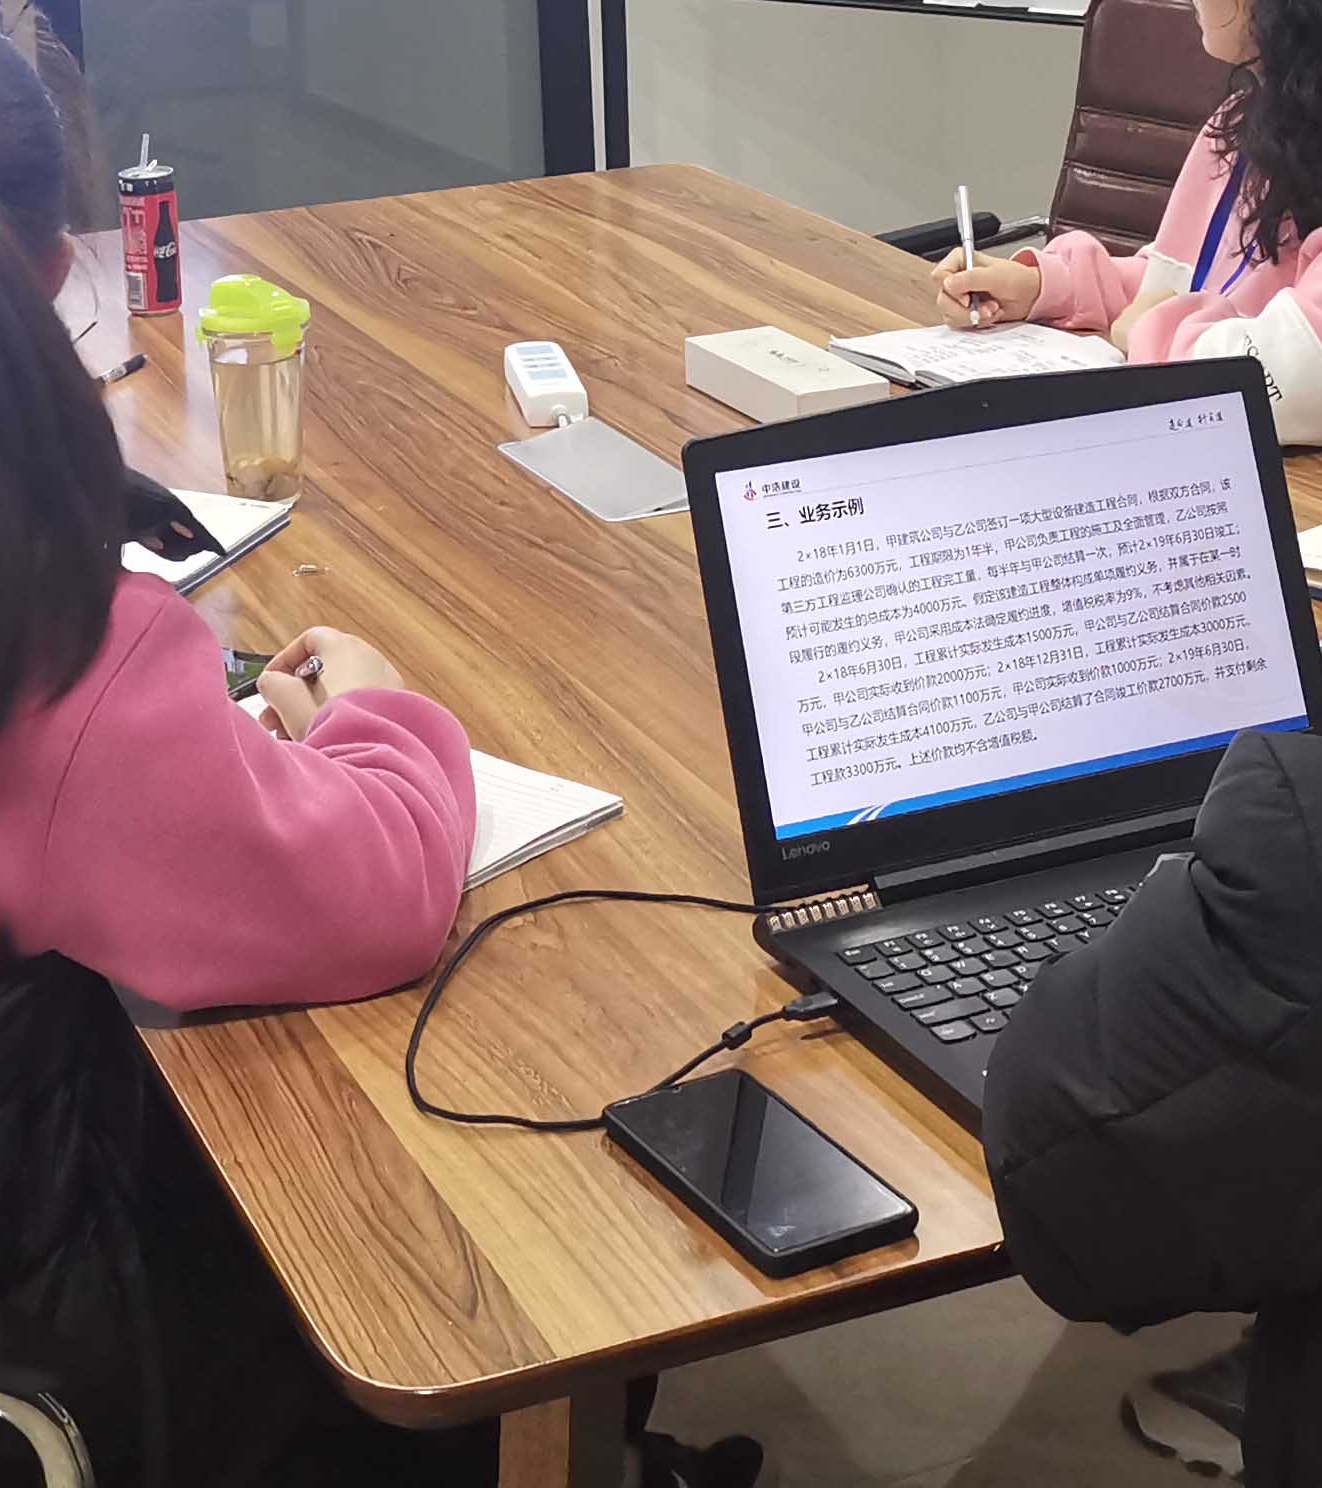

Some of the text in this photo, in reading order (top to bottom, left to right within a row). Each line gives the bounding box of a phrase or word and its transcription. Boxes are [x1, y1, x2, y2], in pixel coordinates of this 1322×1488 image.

[764, 495, 865, 531] 三、业务示例
[781, 840, 831, 861] Lenovo
